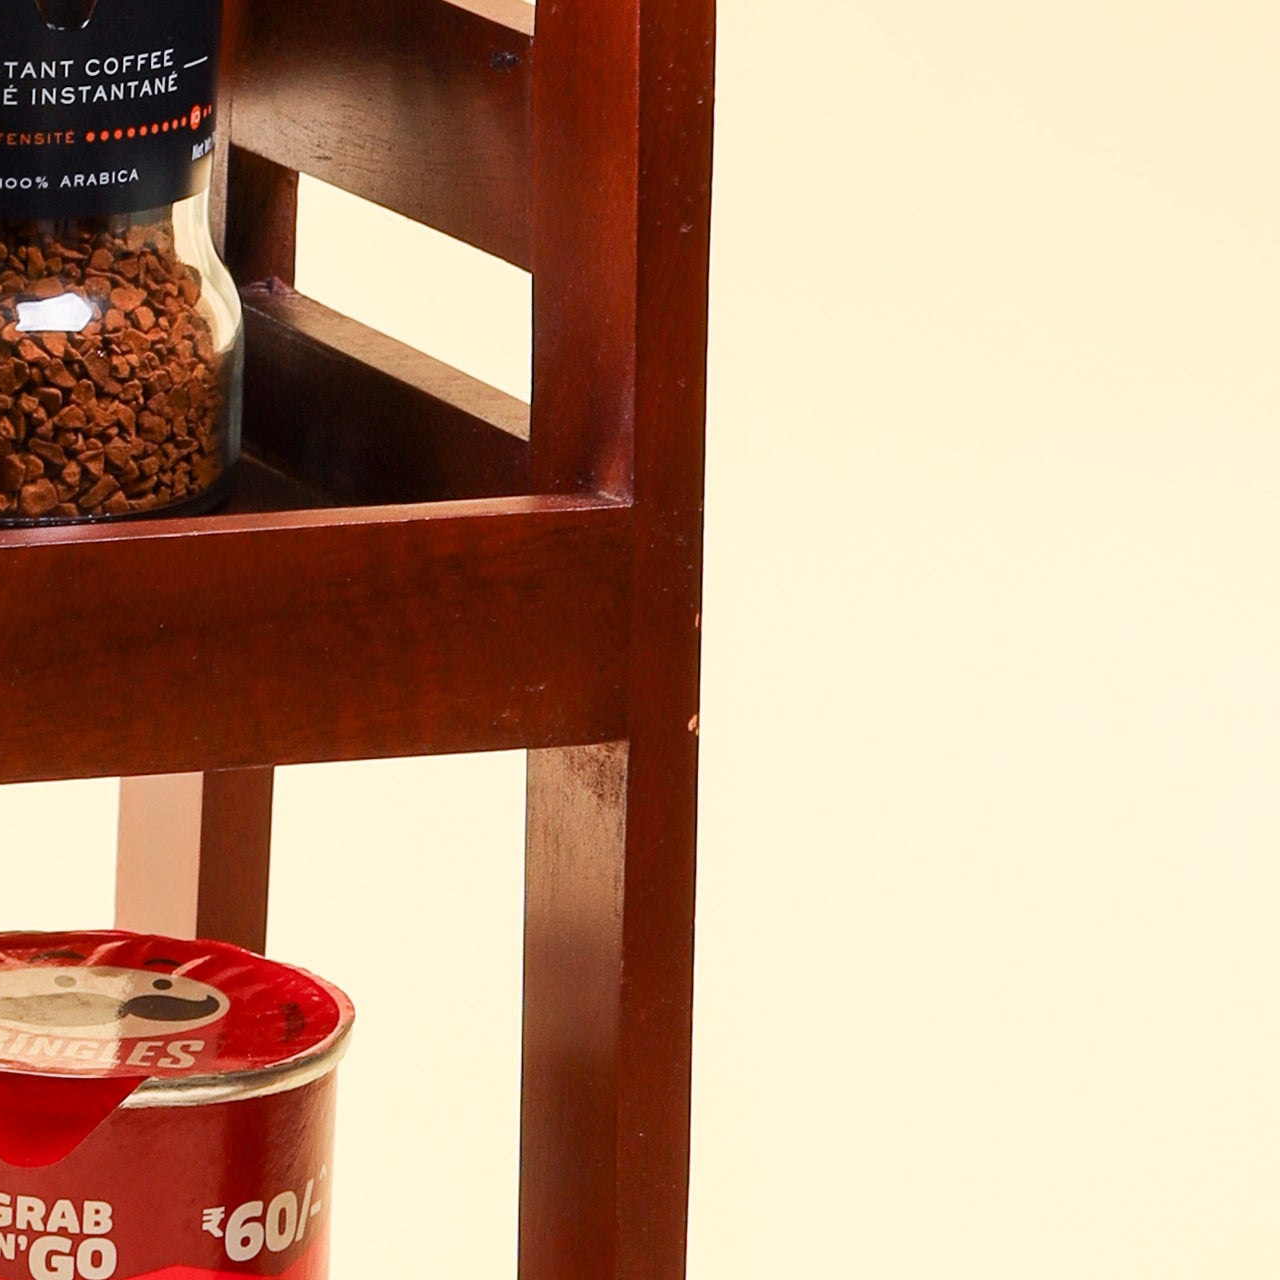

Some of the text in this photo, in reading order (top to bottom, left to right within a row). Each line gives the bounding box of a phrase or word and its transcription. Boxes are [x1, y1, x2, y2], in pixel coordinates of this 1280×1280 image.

[84, 48, 174, 77] COFFEE
[31, 70, 178, 106] INSTANTANÉ
[0, 168, 139, 190] 100% ARABICA
